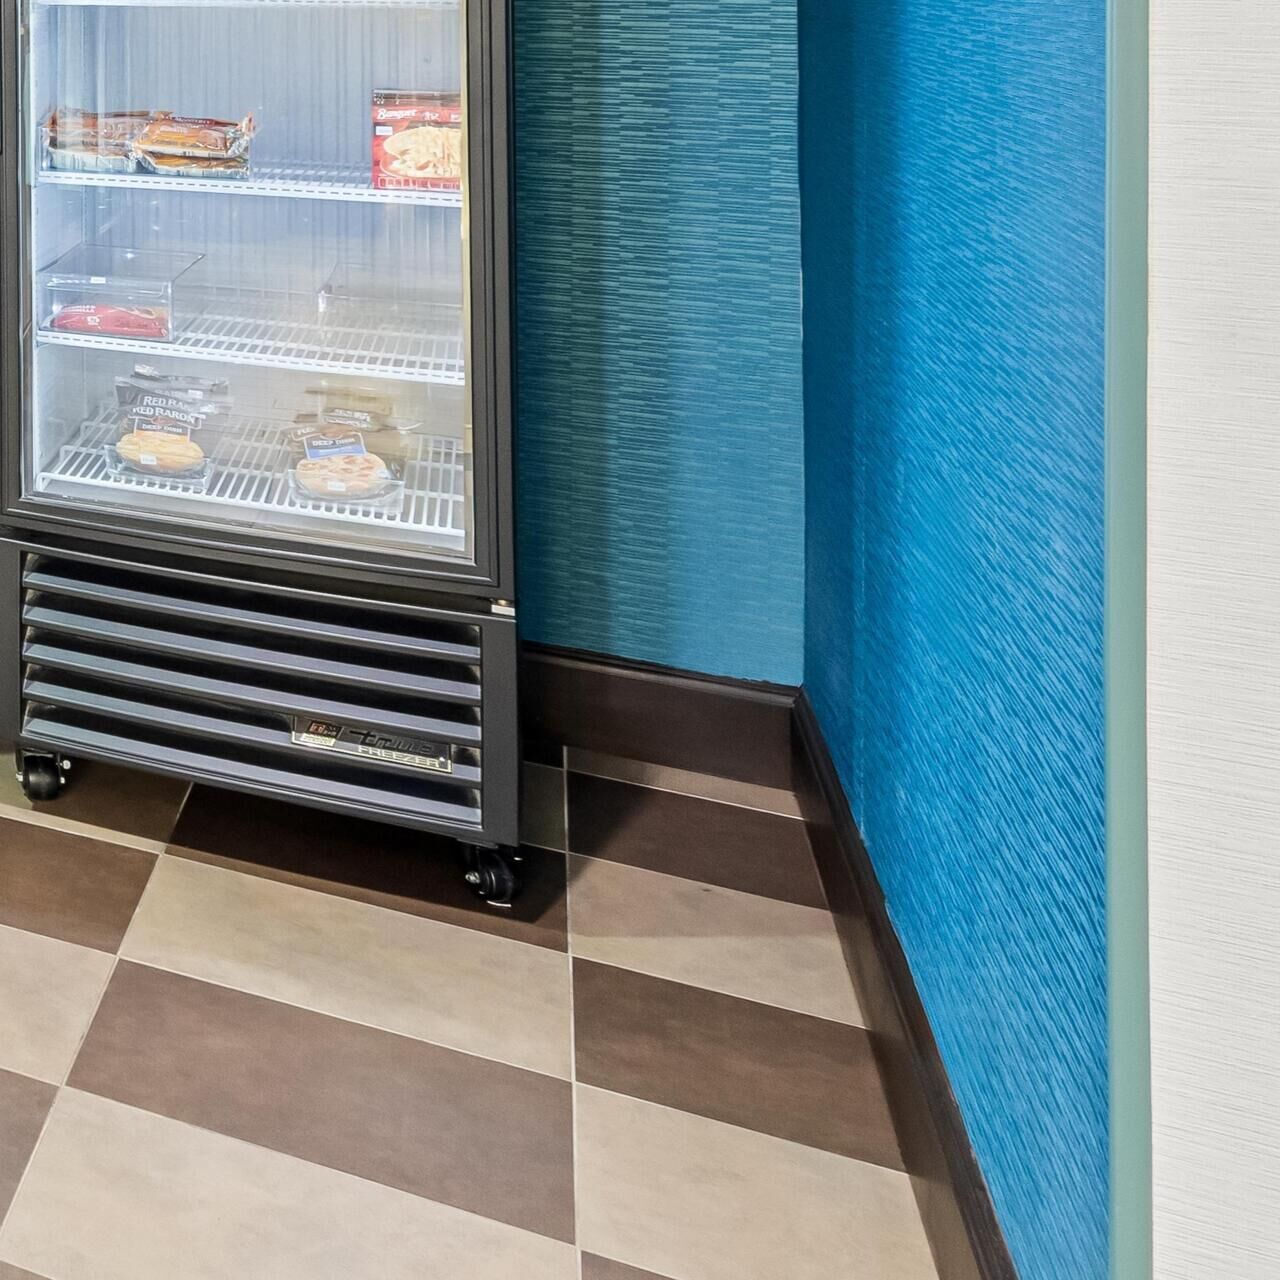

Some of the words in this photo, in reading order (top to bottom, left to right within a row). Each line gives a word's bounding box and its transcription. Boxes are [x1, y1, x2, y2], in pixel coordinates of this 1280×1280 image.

[142, 395, 167, 407] RED
[133, 406, 153, 417] RED
[154, 407, 196, 424] BARON
[357, 745, 440, 768] FREEZER
